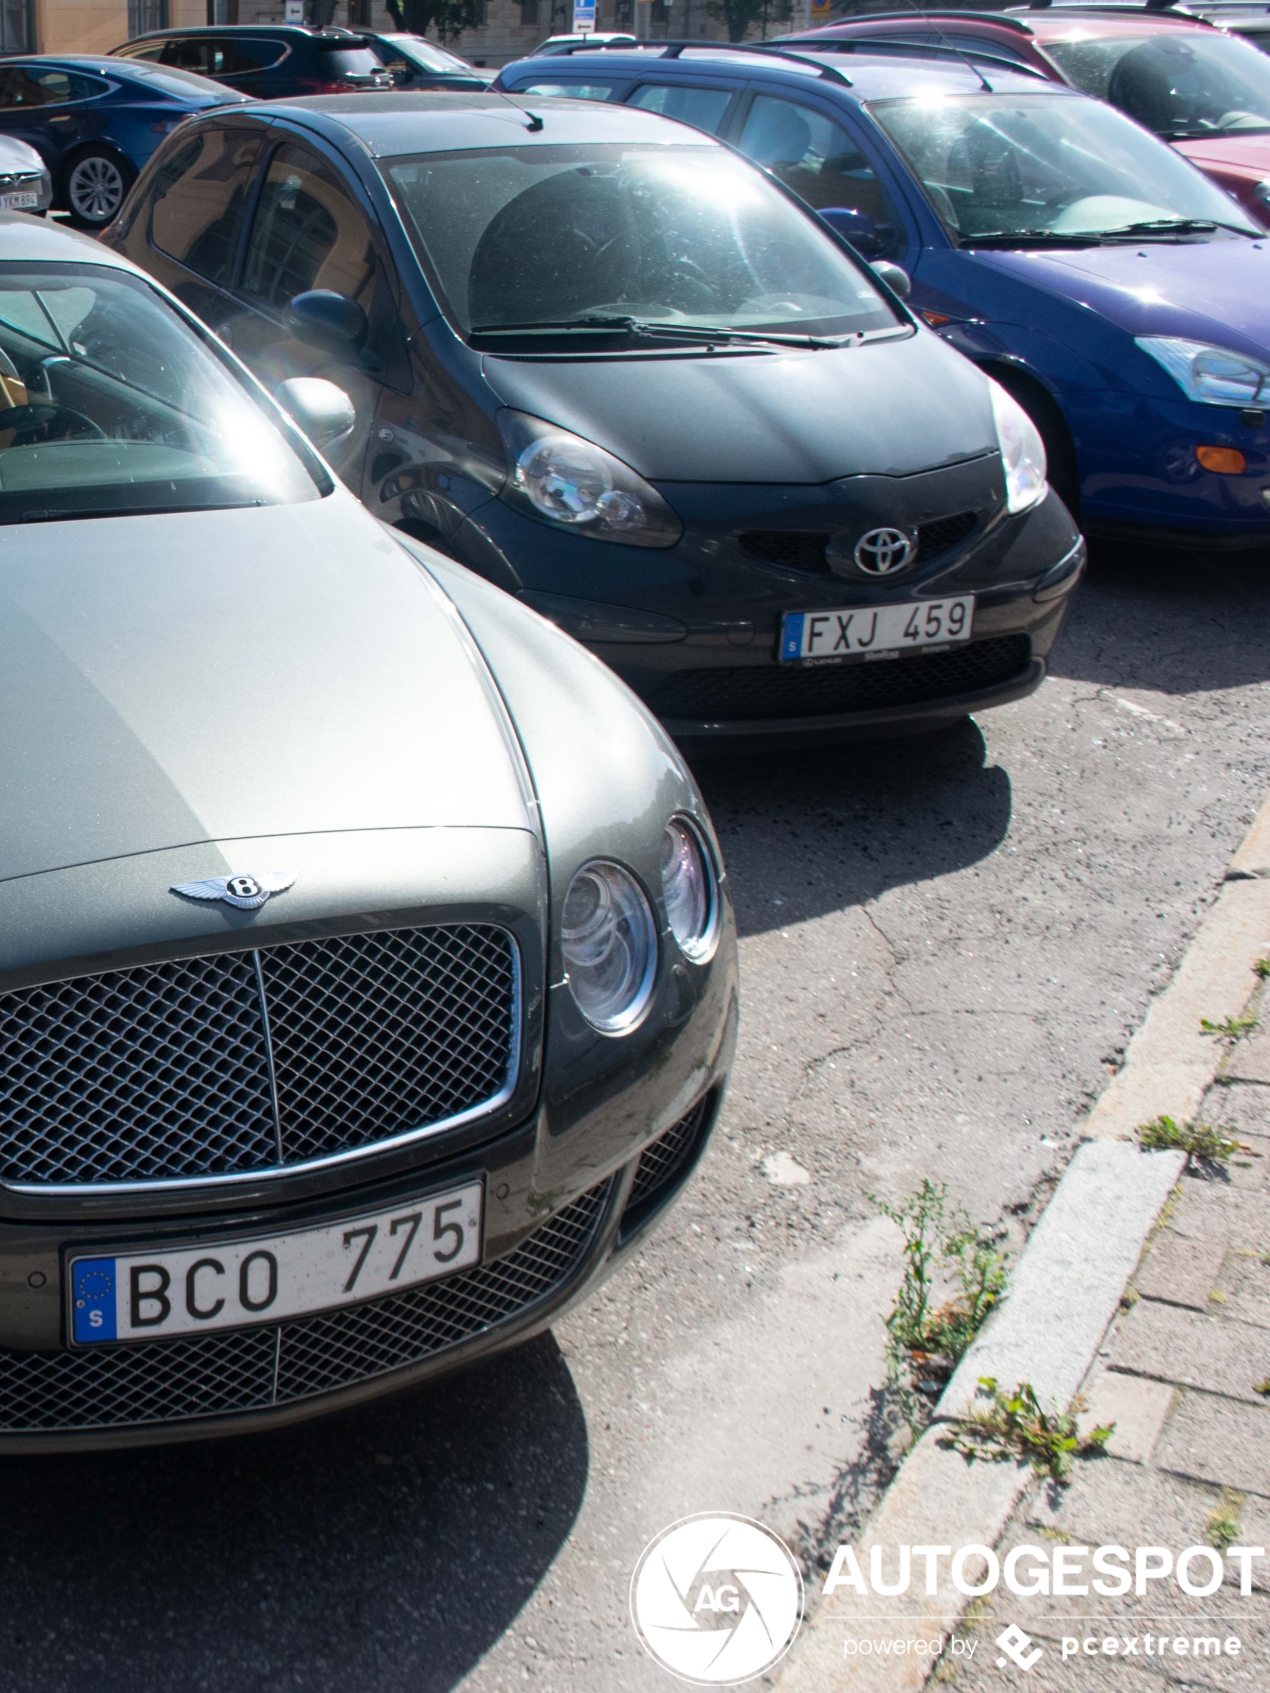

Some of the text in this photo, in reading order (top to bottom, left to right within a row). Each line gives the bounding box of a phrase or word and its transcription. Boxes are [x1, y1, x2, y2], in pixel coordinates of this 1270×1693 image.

[3, 195, 20, 208] YKM
[788, 602, 966, 652] S FXJ 459
[89, 1199, 465, 1328] S BCO 775
